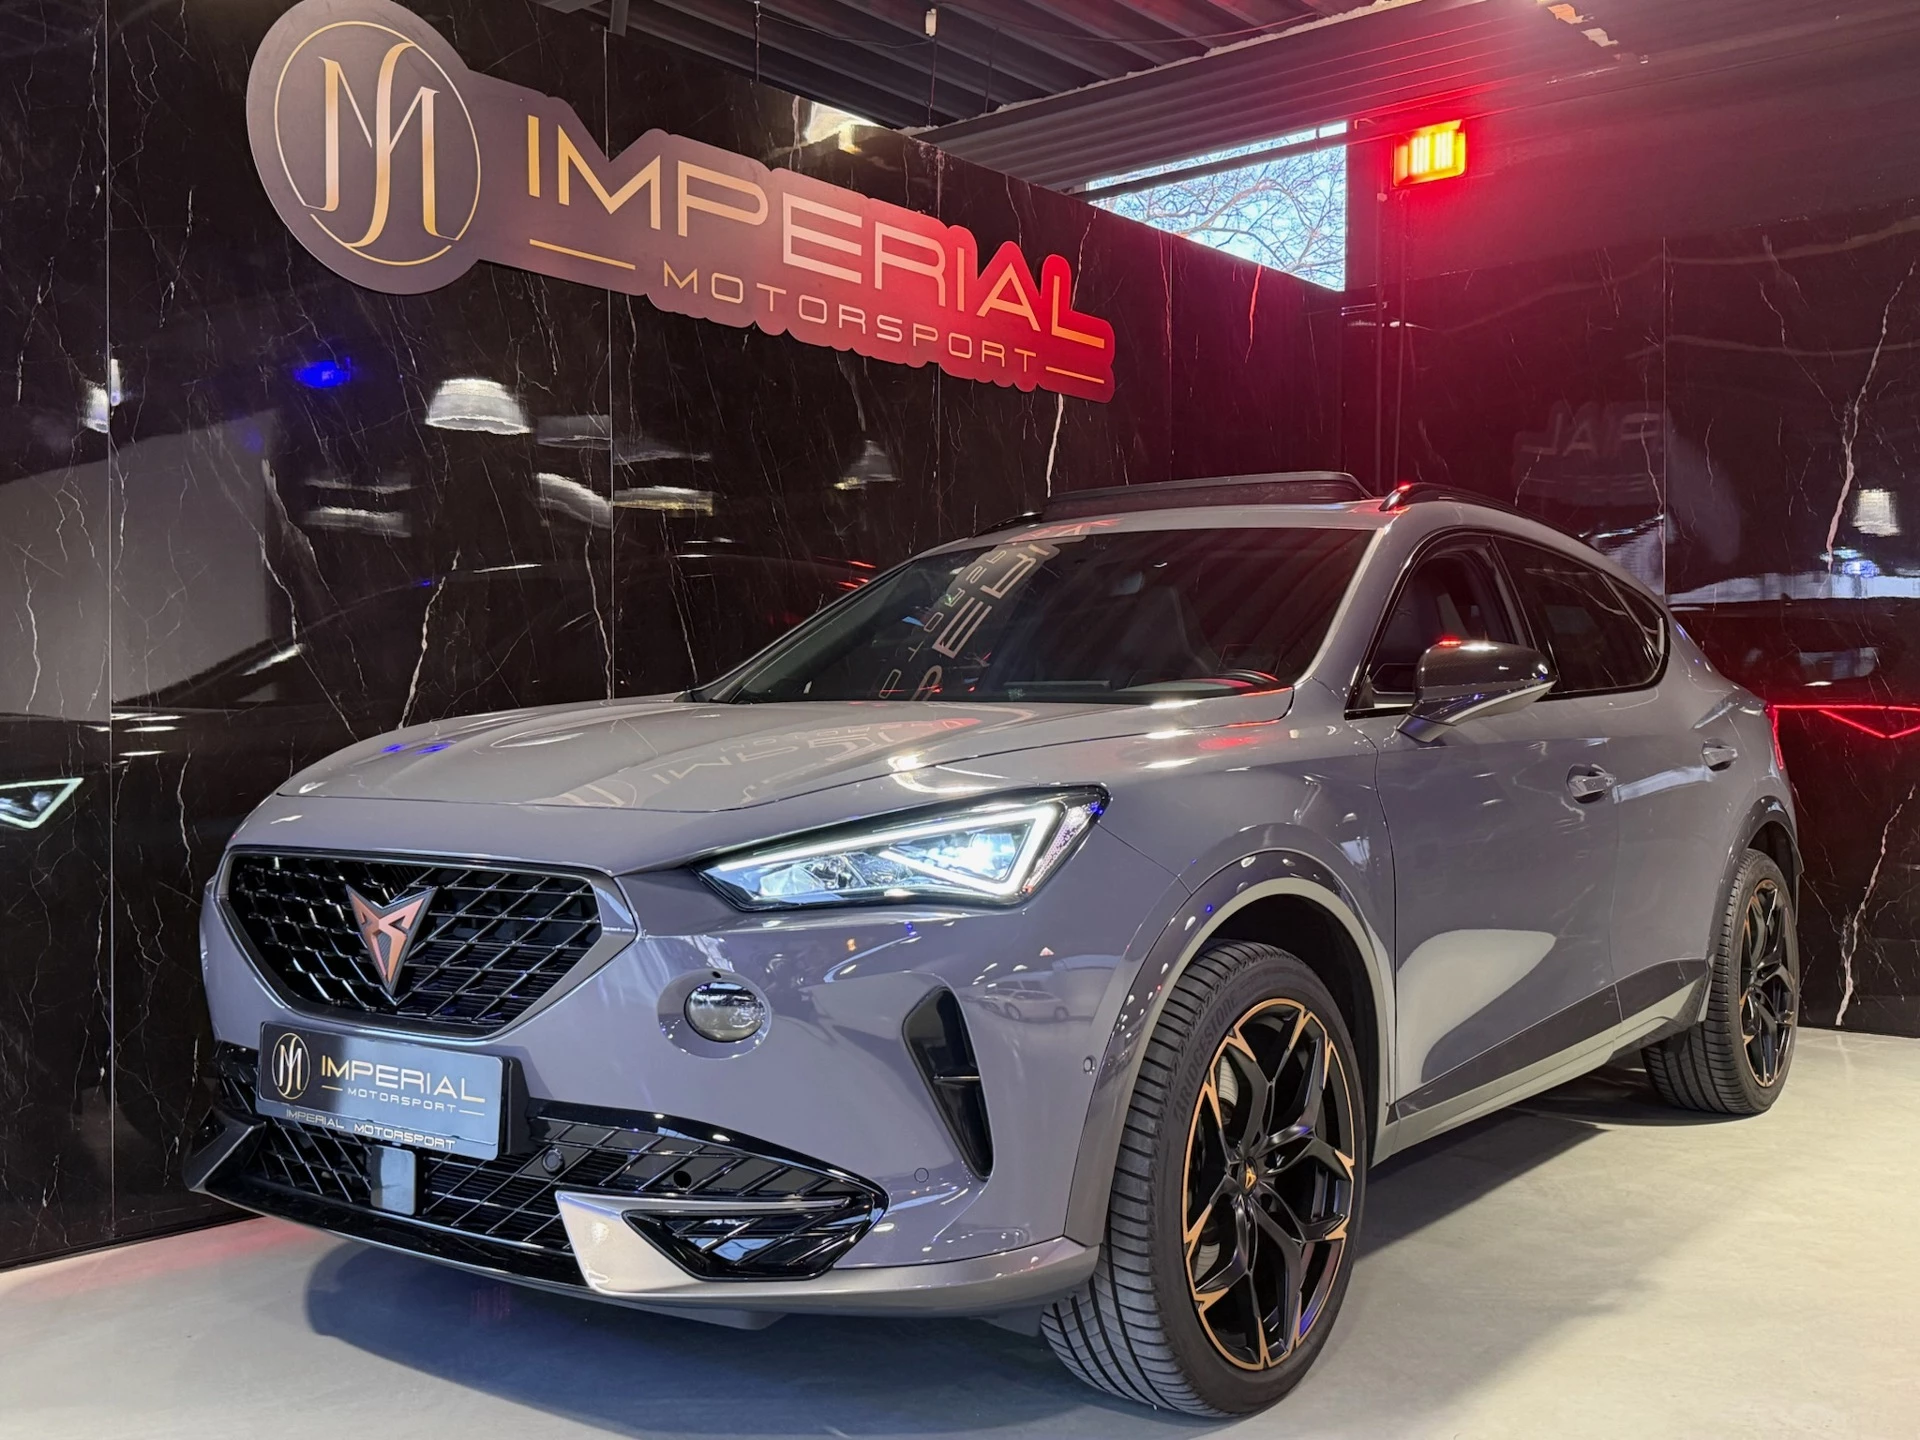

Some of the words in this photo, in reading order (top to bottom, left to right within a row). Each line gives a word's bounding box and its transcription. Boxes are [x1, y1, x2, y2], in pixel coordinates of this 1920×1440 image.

[528, 114, 1105, 349] IMPERIAL
[663, 259, 1037, 373] MOTORSPORT
[321, 1055, 486, 1103] IMPERIAL
[347, 1087, 457, 1113] MOTORSPORT
[286, 1108, 345, 1129] IMPERIAL
[353, 1122, 456, 1150] MOTORSPORT
